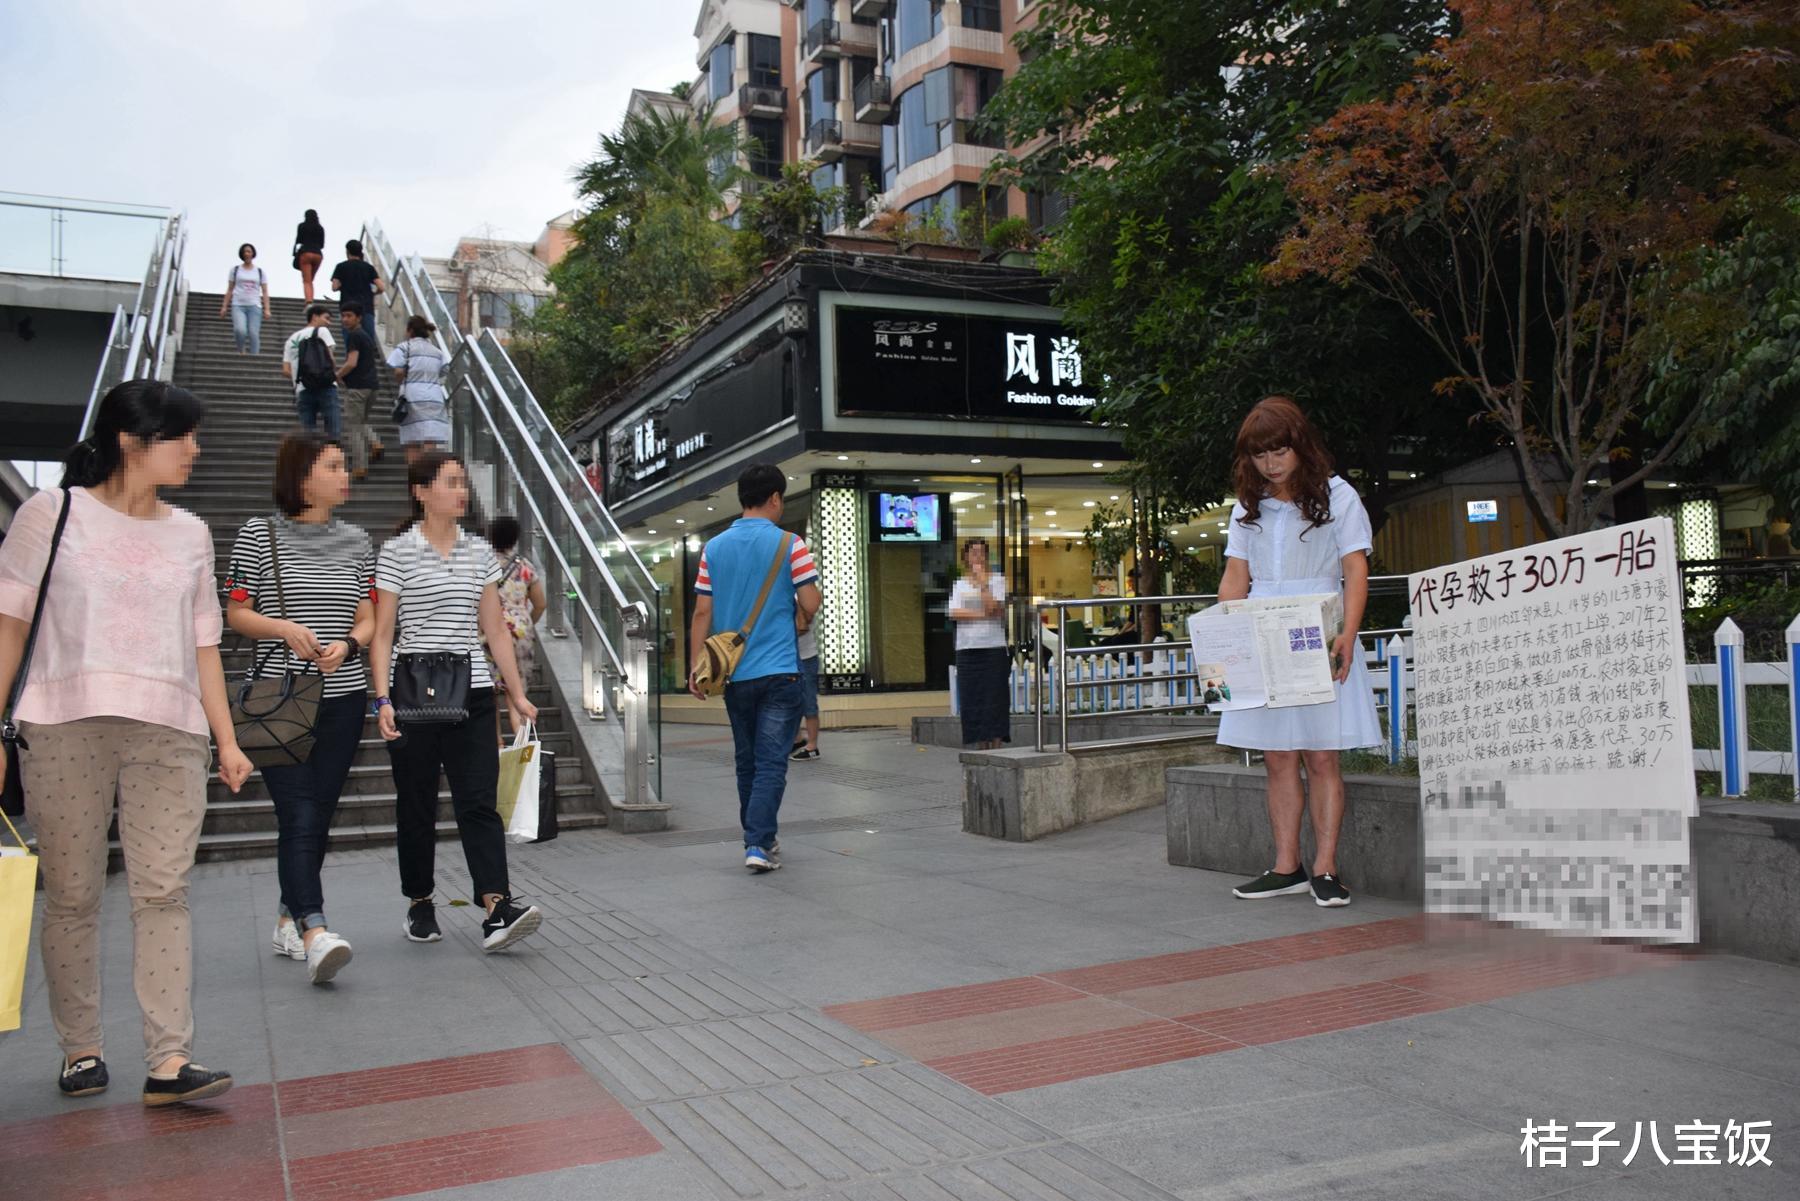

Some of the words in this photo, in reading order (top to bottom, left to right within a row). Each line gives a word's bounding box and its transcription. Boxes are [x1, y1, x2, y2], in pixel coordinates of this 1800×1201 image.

[875, 352, 917, 360] Fashion
[1006, 332, 1082, 387] 风尚
[1007, 391, 1051, 404] Fashion
[1057, 394, 1097, 406] Golden
[1411, 529, 1657, 617] 代孕救子30万一胎
